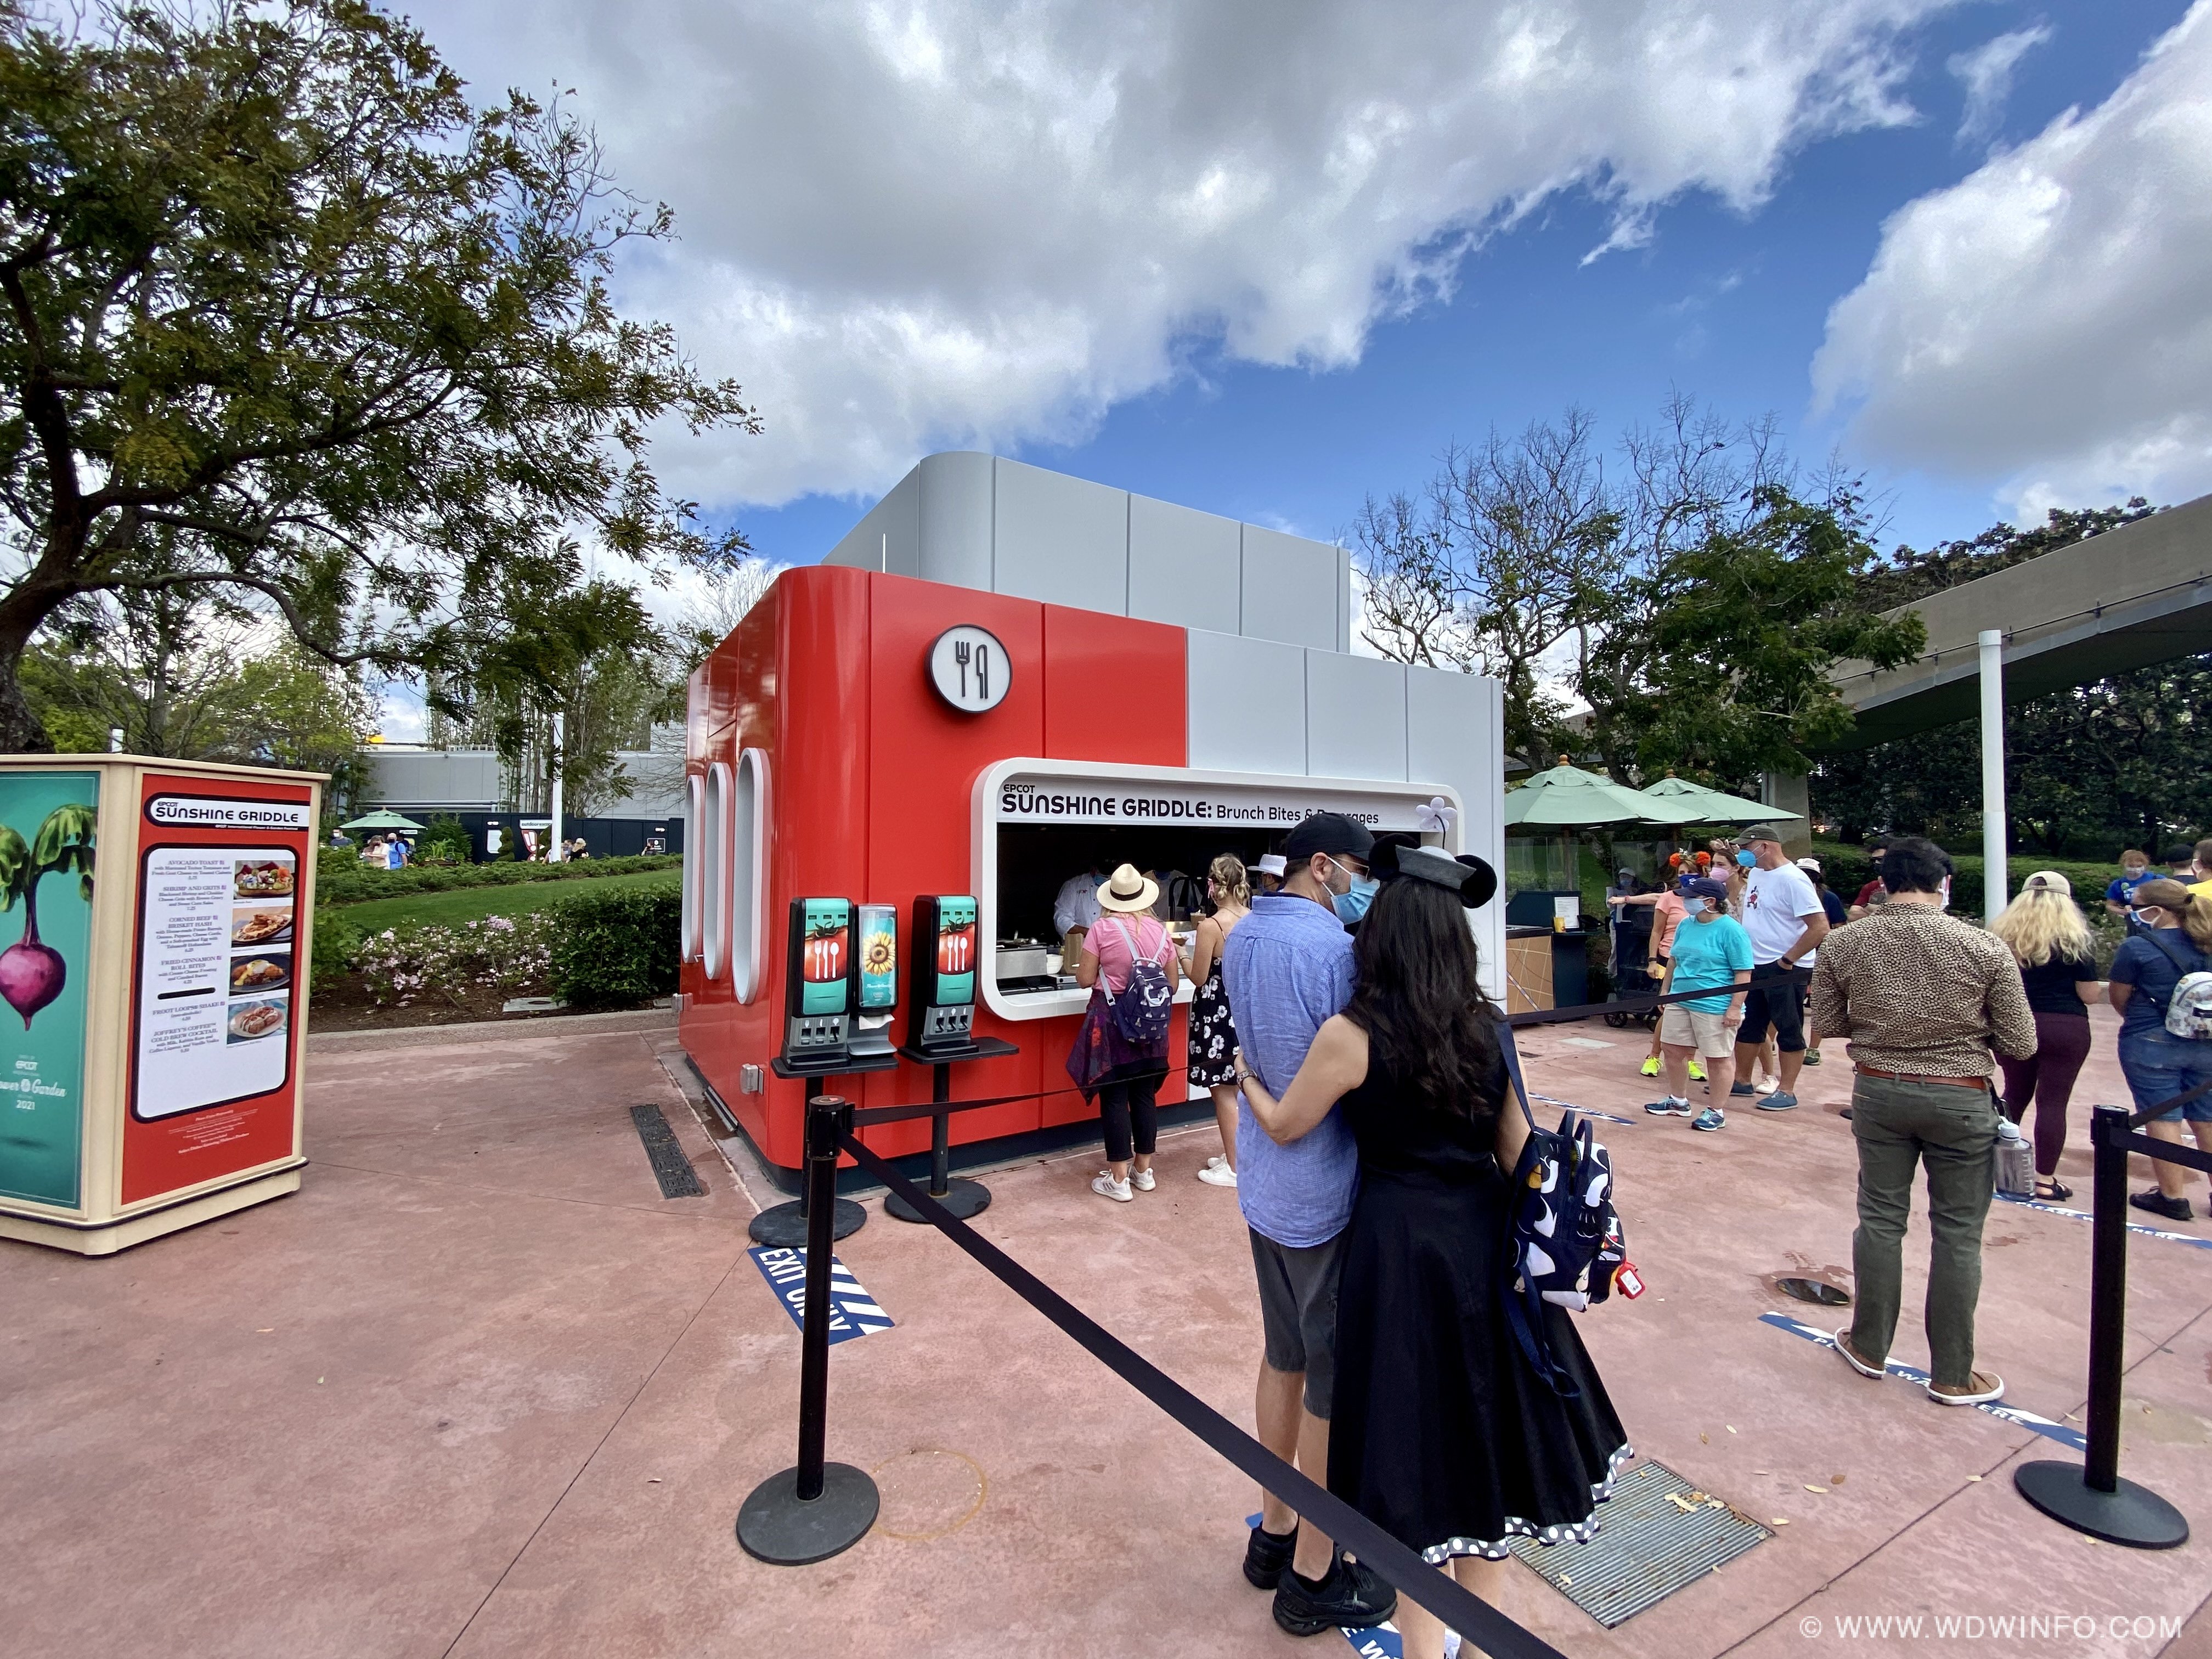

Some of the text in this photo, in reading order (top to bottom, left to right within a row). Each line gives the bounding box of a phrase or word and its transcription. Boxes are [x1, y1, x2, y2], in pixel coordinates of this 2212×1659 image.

[1003, 784, 1035, 794] EPCOT
[156, 807, 298, 822] SUNSHINE GRIDDLE
[1002, 793, 1115, 816] SUNSHINE
[1122, 798, 1212, 818] GRIDDLE:
[1217, 805, 1264, 820] Brunch
[1269, 806, 1301, 821] Bites
[188, 1029, 218, 1037] COCKTAIL
[32, 1079, 66, 1097] Garden
[16, 1100, 35, 1110] 2021
[758, 1248, 807, 1284] EXIT
[1971, 1403, 2024, 1426] ERE
